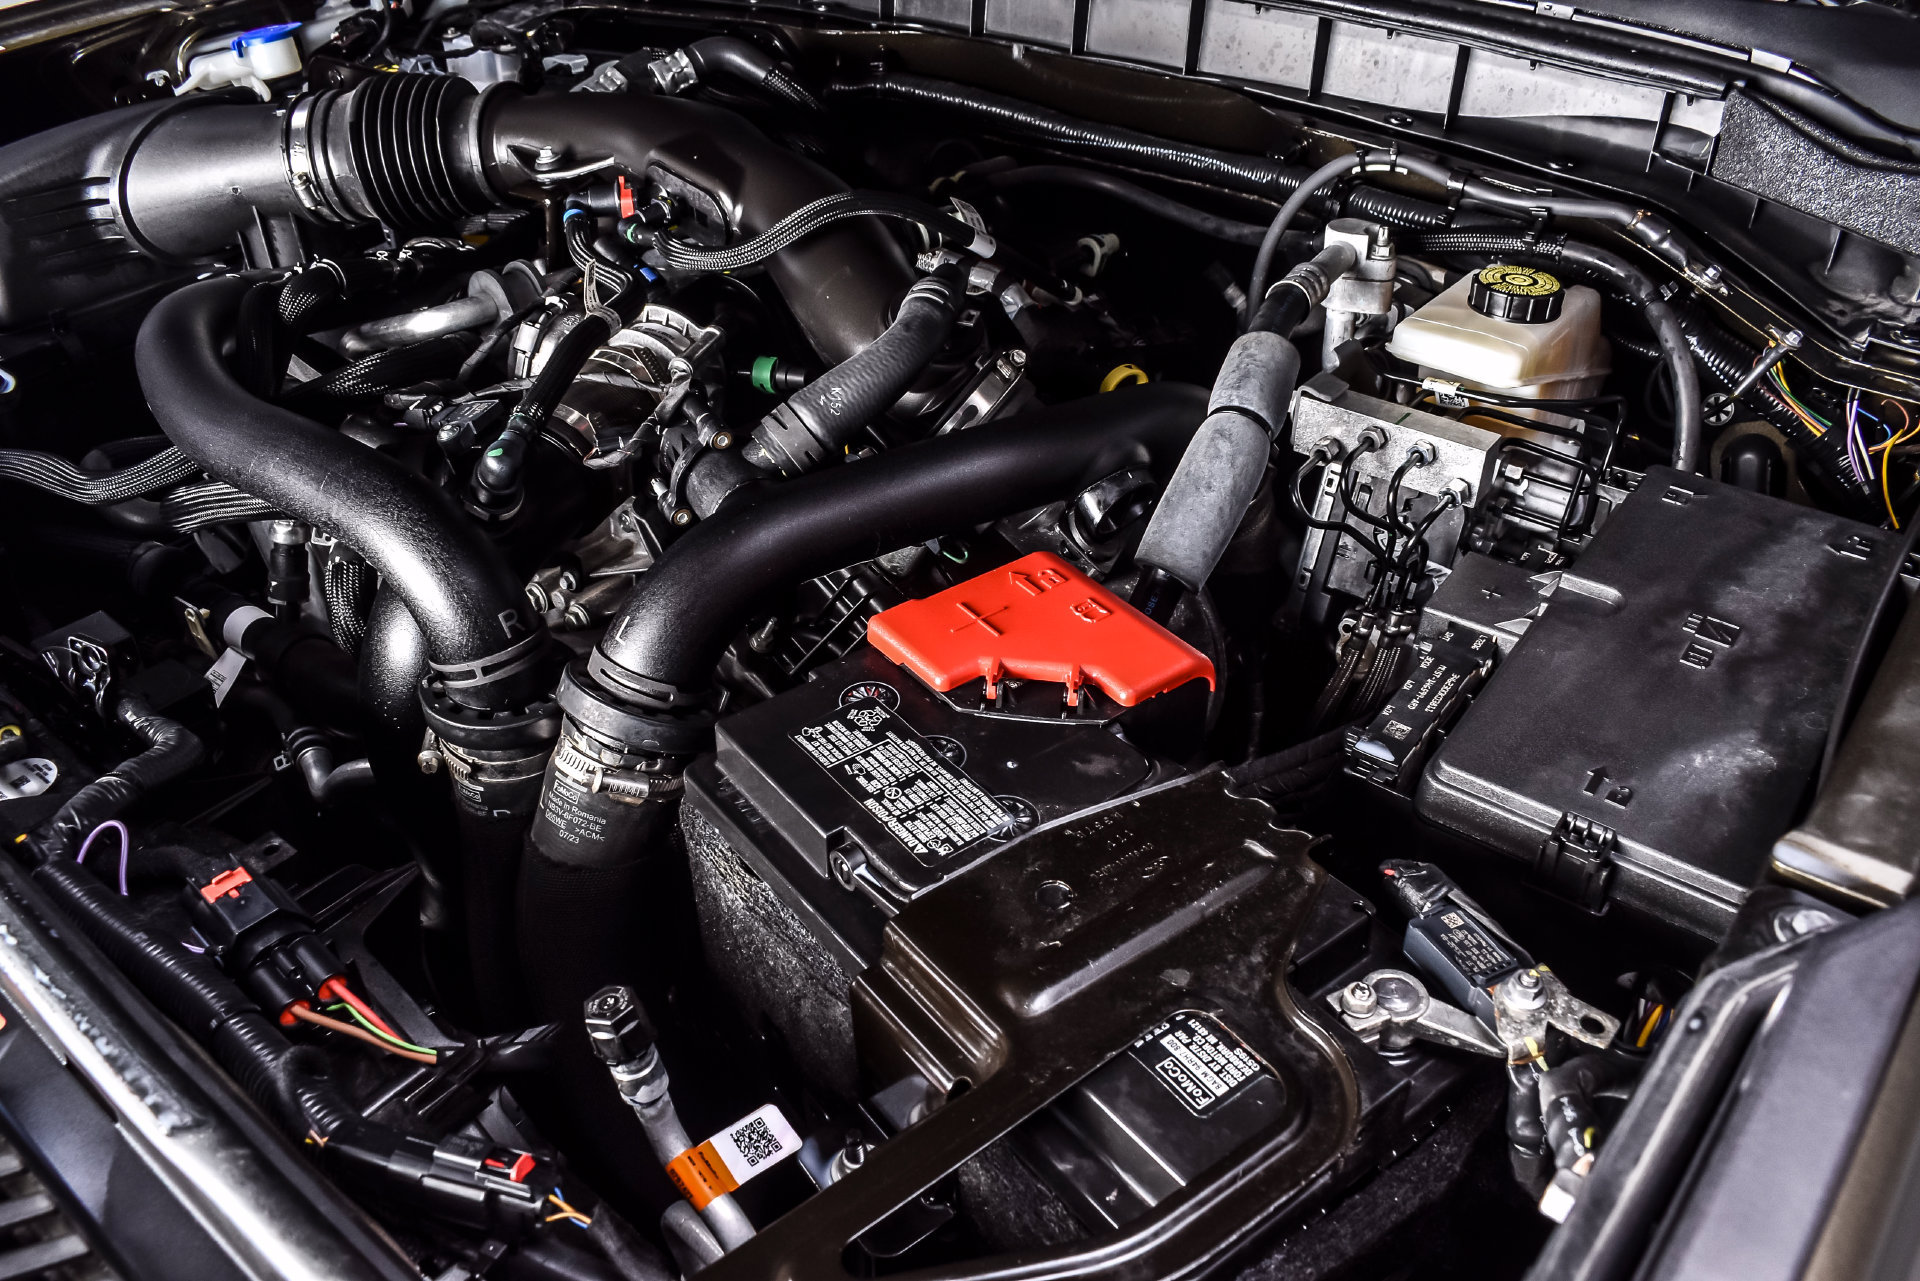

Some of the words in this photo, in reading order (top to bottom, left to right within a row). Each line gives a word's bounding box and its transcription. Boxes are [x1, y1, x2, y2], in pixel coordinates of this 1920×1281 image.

[498, 608, 525, 639] R
[615, 615, 630, 646] L
[573, 808, 607, 825] Romania
[863, 798, 919, 847] DANGER/POISON
[558, 829, 580, 844] 07/23
[1174, 1030, 1191, 1044] PAR
[1188, 1019, 1208, 1036] 48121
[1202, 1041, 1228, 1066] MOTOR
[1208, 1061, 1222, 1072] BY
[1225, 1063, 1246, 1082] FORD
[1165, 1061, 1210, 1107] FoMoCo
